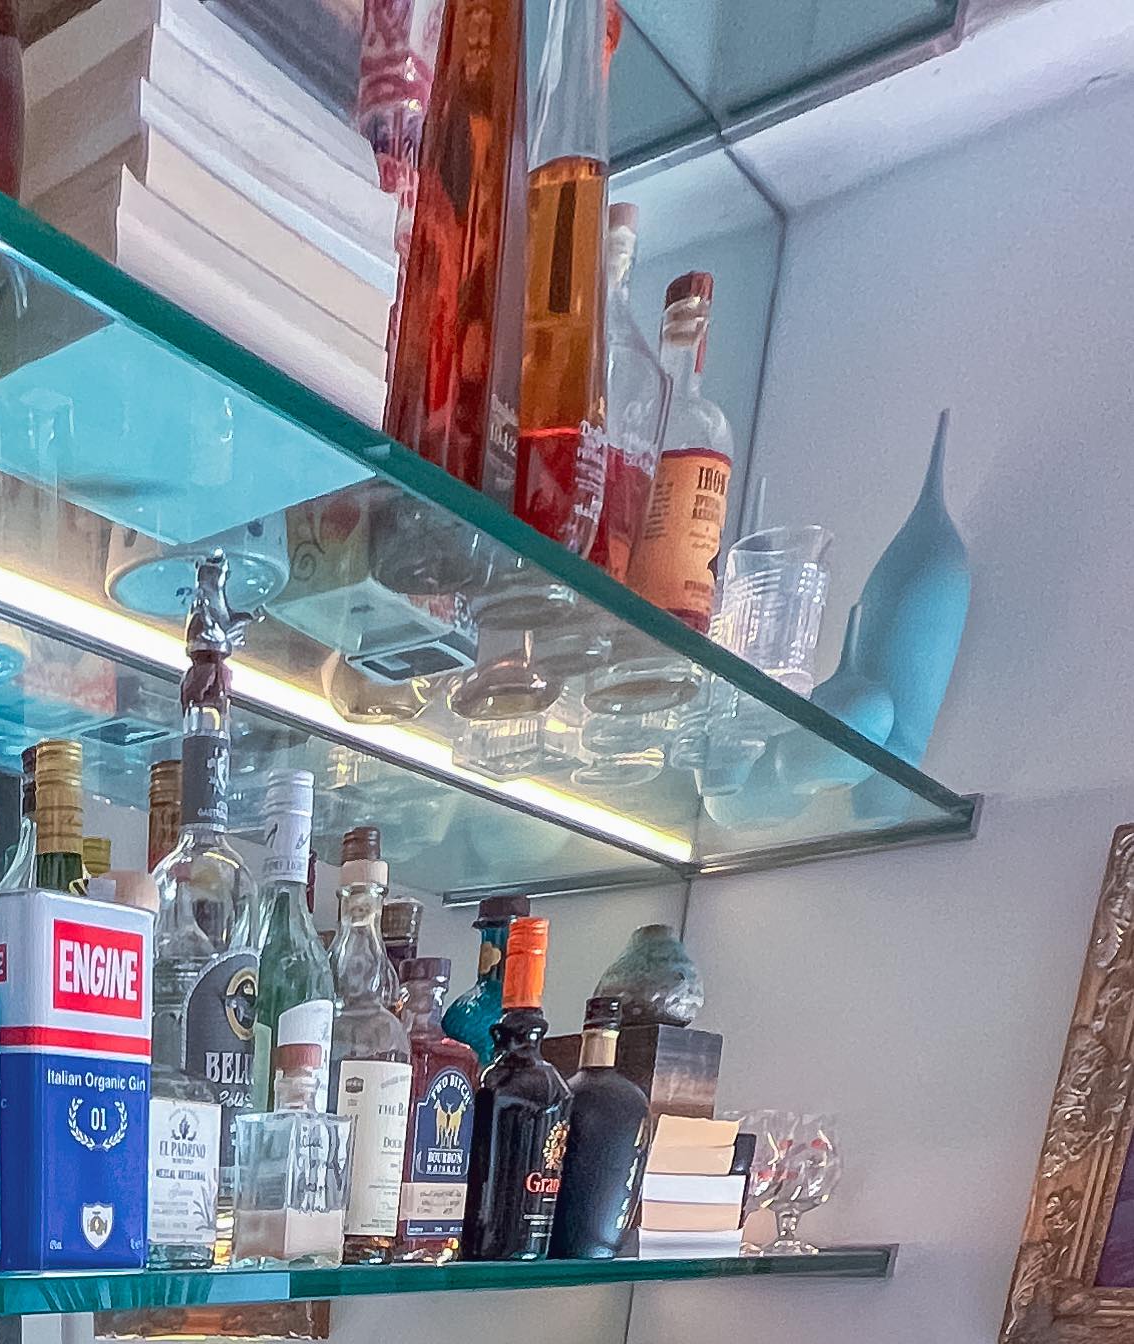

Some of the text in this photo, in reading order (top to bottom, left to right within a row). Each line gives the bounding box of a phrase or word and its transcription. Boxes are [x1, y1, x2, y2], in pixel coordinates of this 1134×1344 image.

[59, 939, 138, 1001] ENGINE
[47, 1068, 146, 1092] Italian Organic Gin
[430, 1075, 449, 1101] TWO
[90, 1107, 107, 1131] 01
[159, 1140, 206, 1159] EL PADRINO
[427, 1151, 463, 1164] BOURBON
